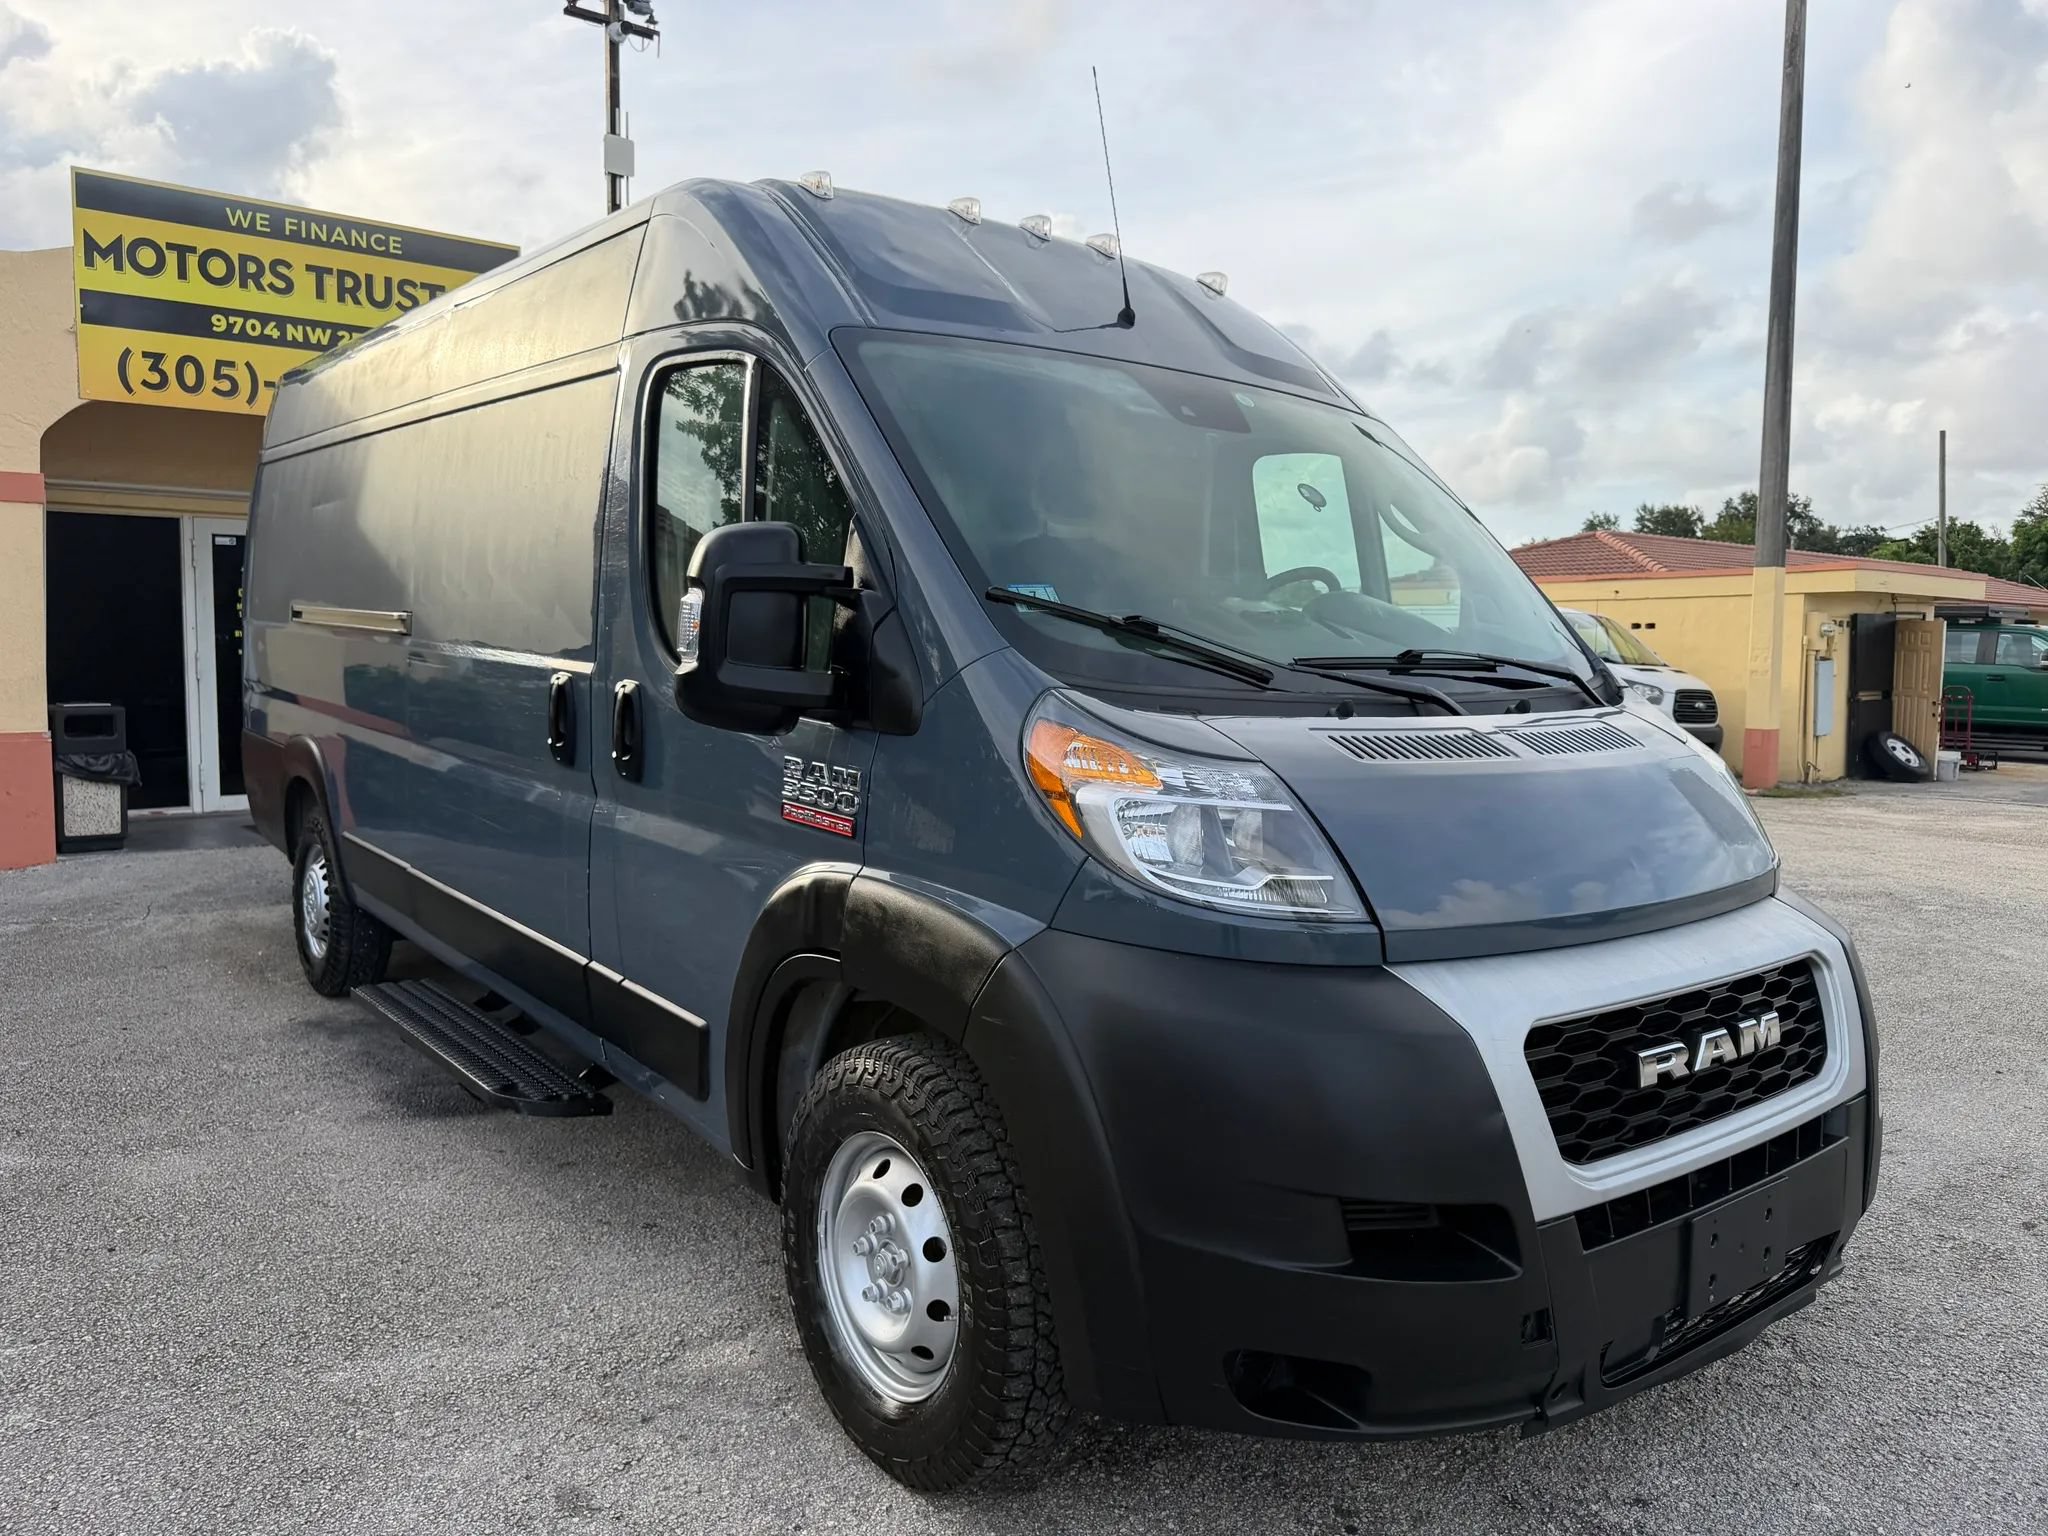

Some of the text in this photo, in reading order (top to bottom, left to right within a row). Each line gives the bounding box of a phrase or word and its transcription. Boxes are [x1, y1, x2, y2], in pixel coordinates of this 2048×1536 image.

[225, 207, 403, 255] WE FINANCE
[83, 228, 446, 313] MOTORS TRUST
[211, 314, 281, 340] 9704
[287, 323, 332, 346] NW
[784, 755, 862, 793] RAM
[781, 777, 860, 816] 3500
[1637, 1011, 1782, 1088] RAM
